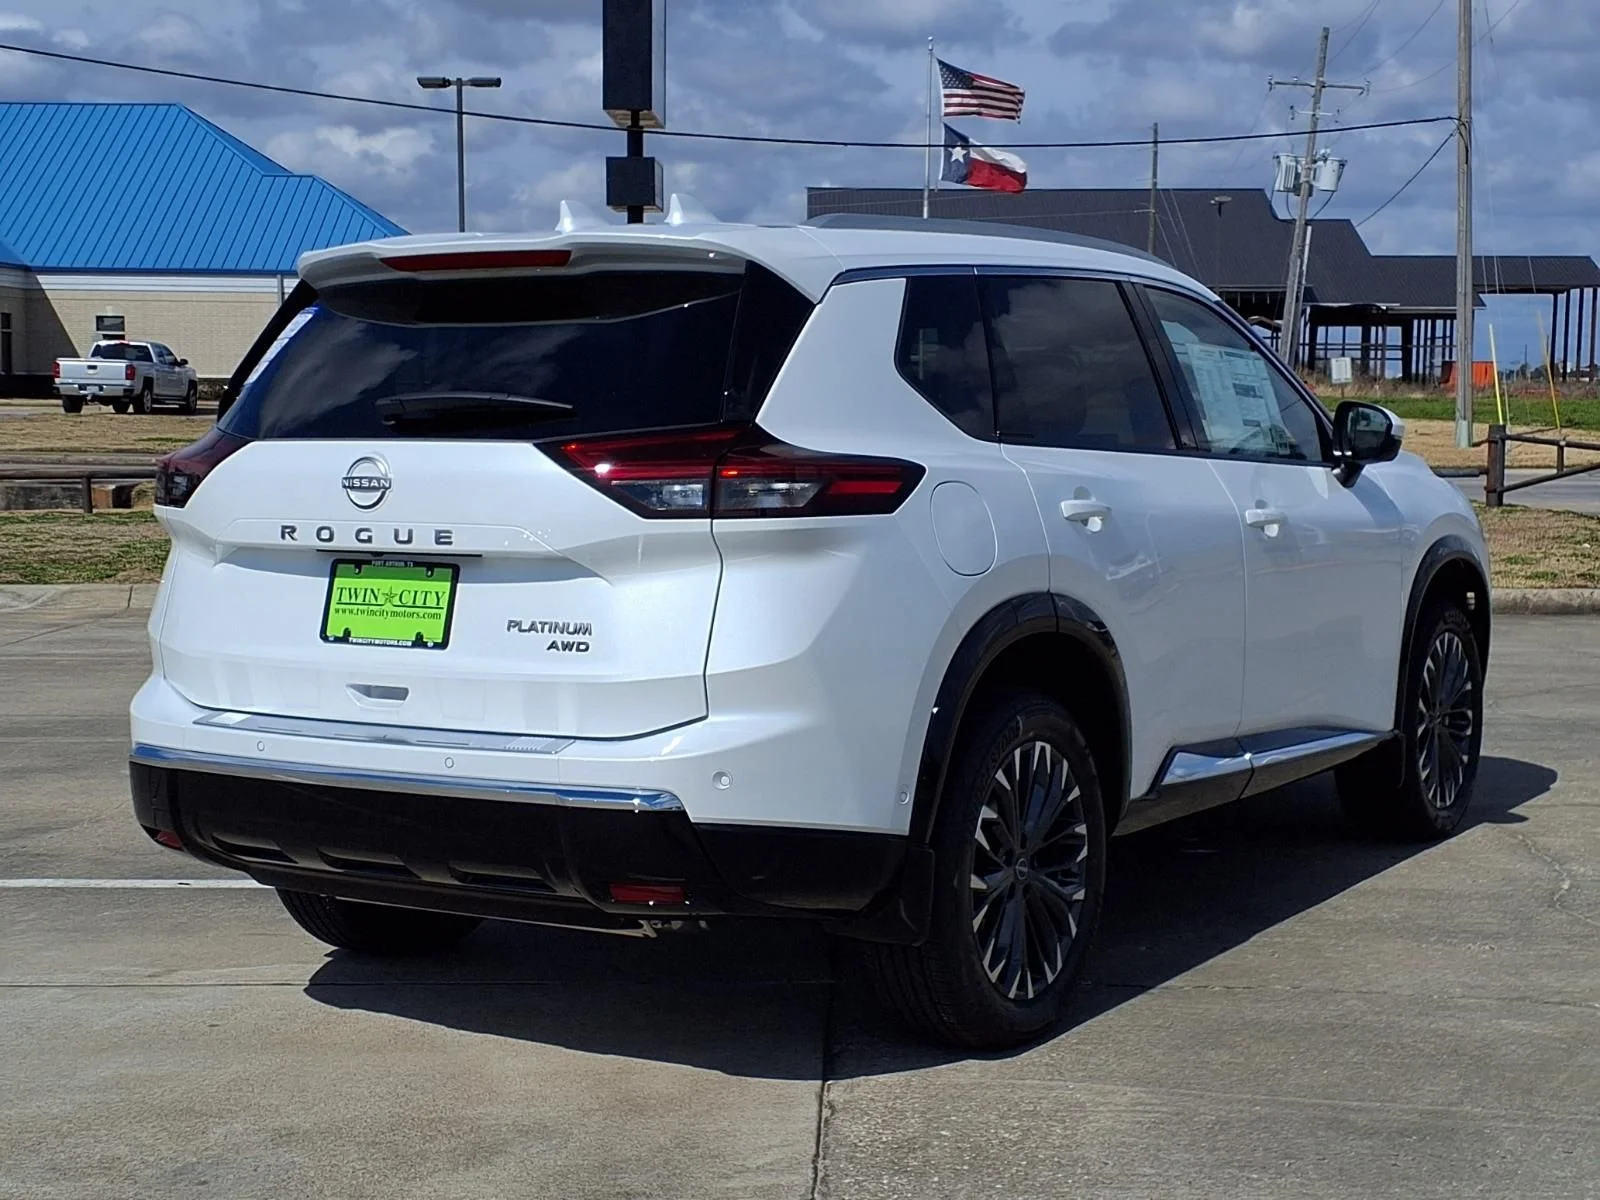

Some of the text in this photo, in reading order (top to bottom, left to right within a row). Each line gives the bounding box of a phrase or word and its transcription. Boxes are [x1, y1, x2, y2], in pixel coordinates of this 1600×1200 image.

[342, 477, 390, 489] NISSAN
[281, 525, 454, 546] ROGUE
[337, 586, 447, 606] TWIN CITY
[334, 606, 442, 620] www.twincitymotors.com
[507, 619, 593, 636] PLATINUM
[546, 640, 590, 652] AWD
